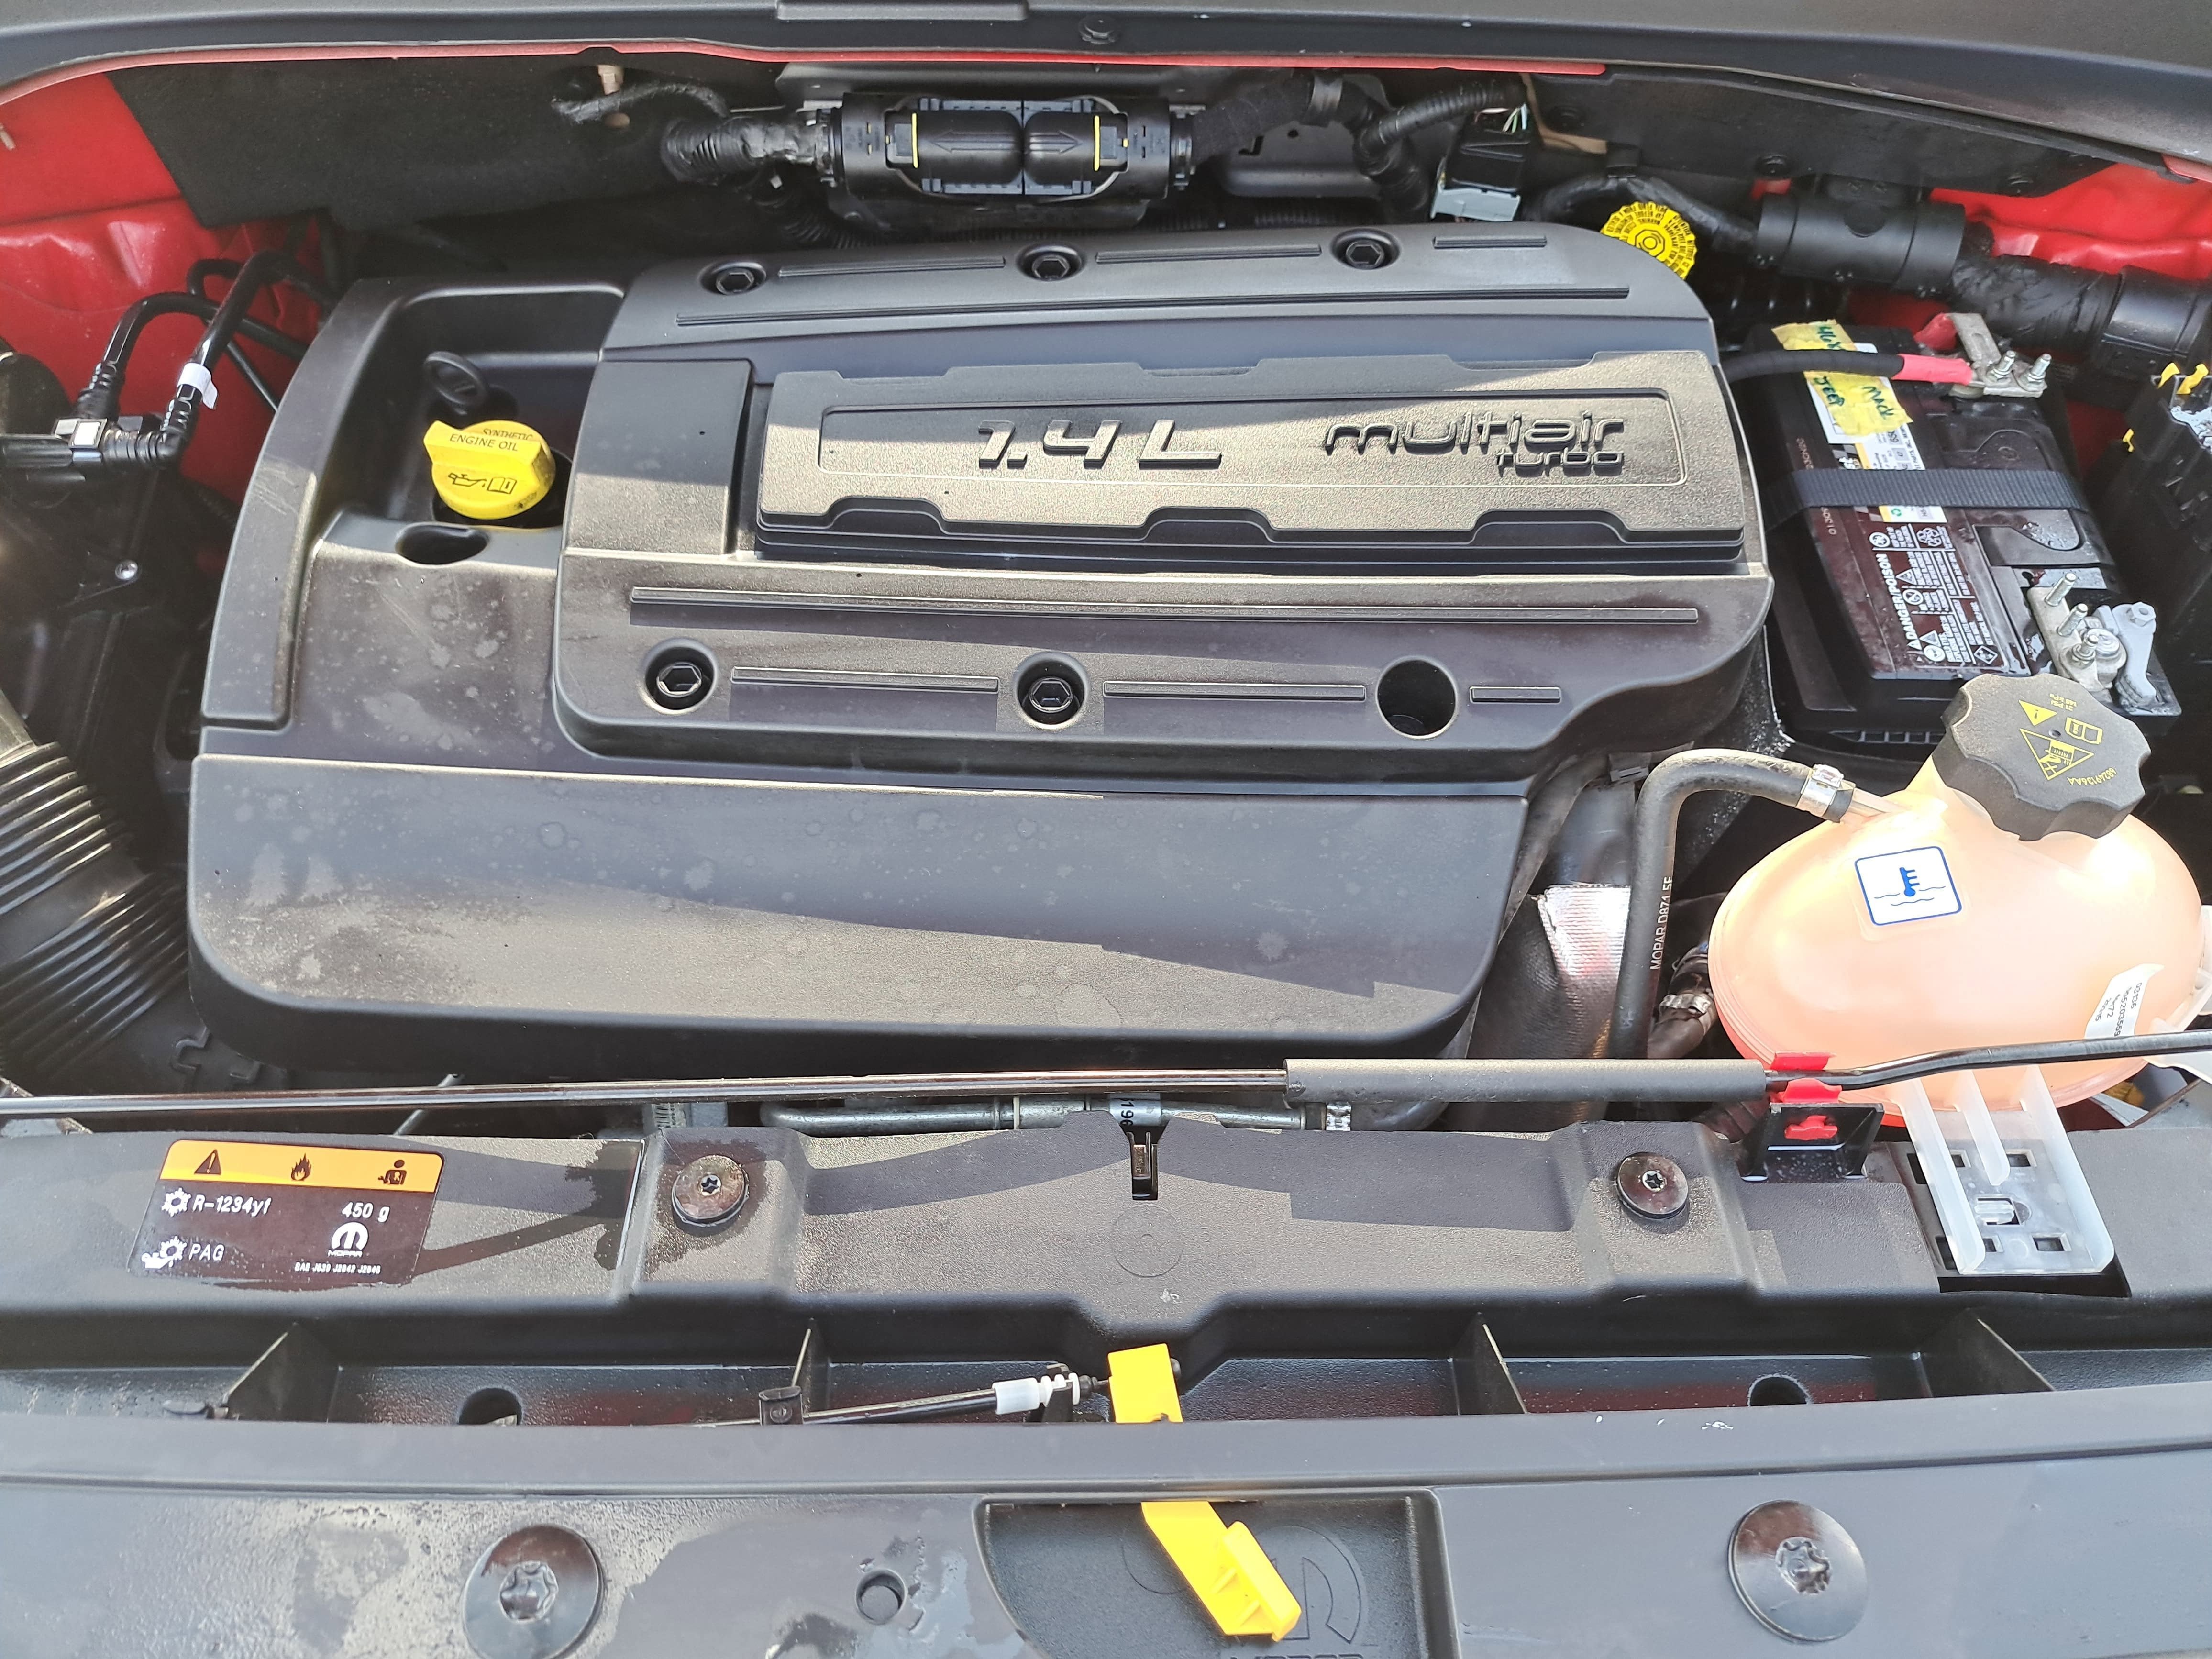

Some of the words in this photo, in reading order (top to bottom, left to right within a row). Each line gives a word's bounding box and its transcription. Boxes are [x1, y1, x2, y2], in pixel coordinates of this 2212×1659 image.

[450, 433, 495, 448] ENGINE
[498, 441, 518, 451] OIL
[483, 429, 533, 441] SYNTHETIC
[1324, 410, 1624, 454] multiair
[1497, 446, 1624, 477] turbo
[1876, 553, 1918, 640] DANGER/POISON
[1650, 927, 1666, 970] MOPAR
[1658, 895, 1670, 924] D871
[192, 1194, 272, 1217] R-1234yf
[342, 1202, 373, 1218] 450
[378, 1206, 390, 1223] g
[189, 1243, 224, 1261] PAG
